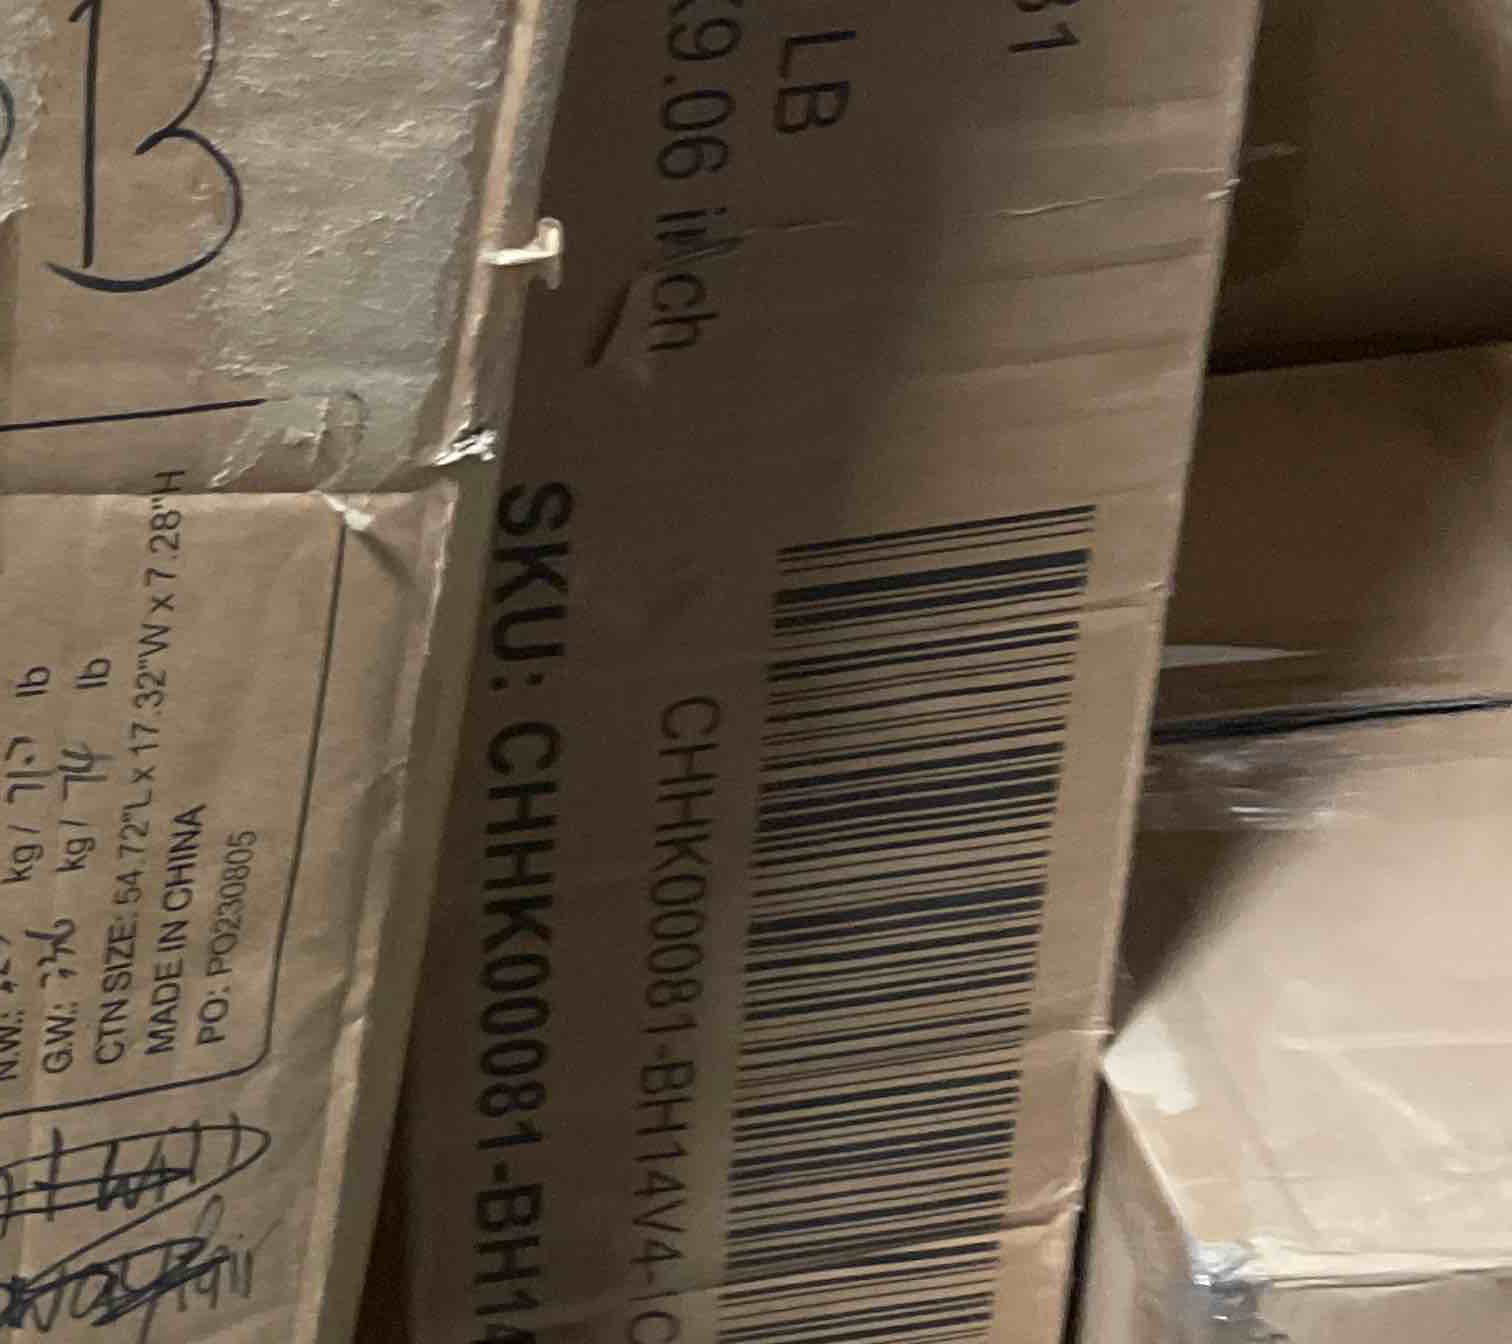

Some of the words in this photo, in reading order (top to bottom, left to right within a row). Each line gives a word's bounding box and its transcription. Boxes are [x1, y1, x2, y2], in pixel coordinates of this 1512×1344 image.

[772, 29, 858, 137] LB
[149, 591, 175, 614] x
[488, 482, 575, 693] SKU:
[15, 664, 52, 698] lb
[74, 656, 113, 691] lb
[132, 761, 157, 785] x
[0, 842, 45, 886] kg
[55, 835, 96, 874] kg
[162, 801, 207, 919] CHINA
[203, 827, 258, 977] PO230805
[103, 909, 137, 992] SIZE:
[157, 923, 189, 964] IN
[93, 992, 128, 1067] CTN
[144, 964, 185, 1056] MADE
[196, 979, 232, 1047] PO:
